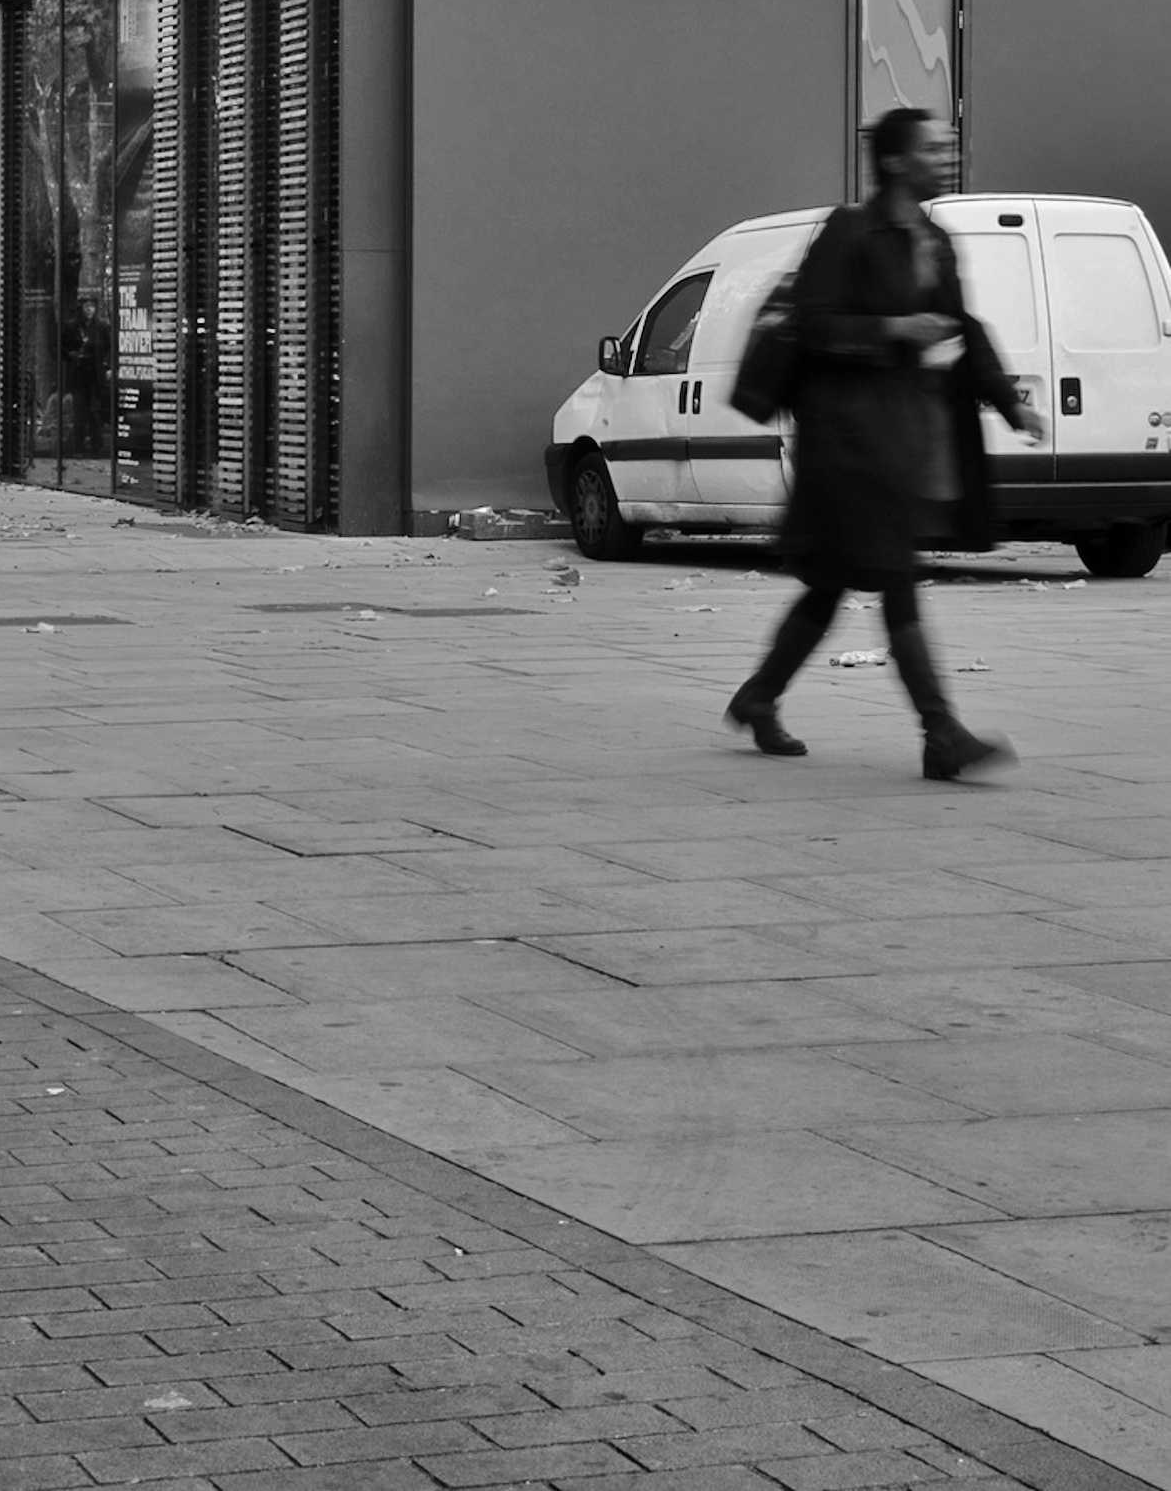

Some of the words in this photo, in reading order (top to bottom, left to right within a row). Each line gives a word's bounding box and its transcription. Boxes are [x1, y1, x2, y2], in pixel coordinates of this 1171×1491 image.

[118, 285, 137, 307] THE
[118, 307, 148, 331] TRAIN
[118, 330, 152, 353] DRIVER
